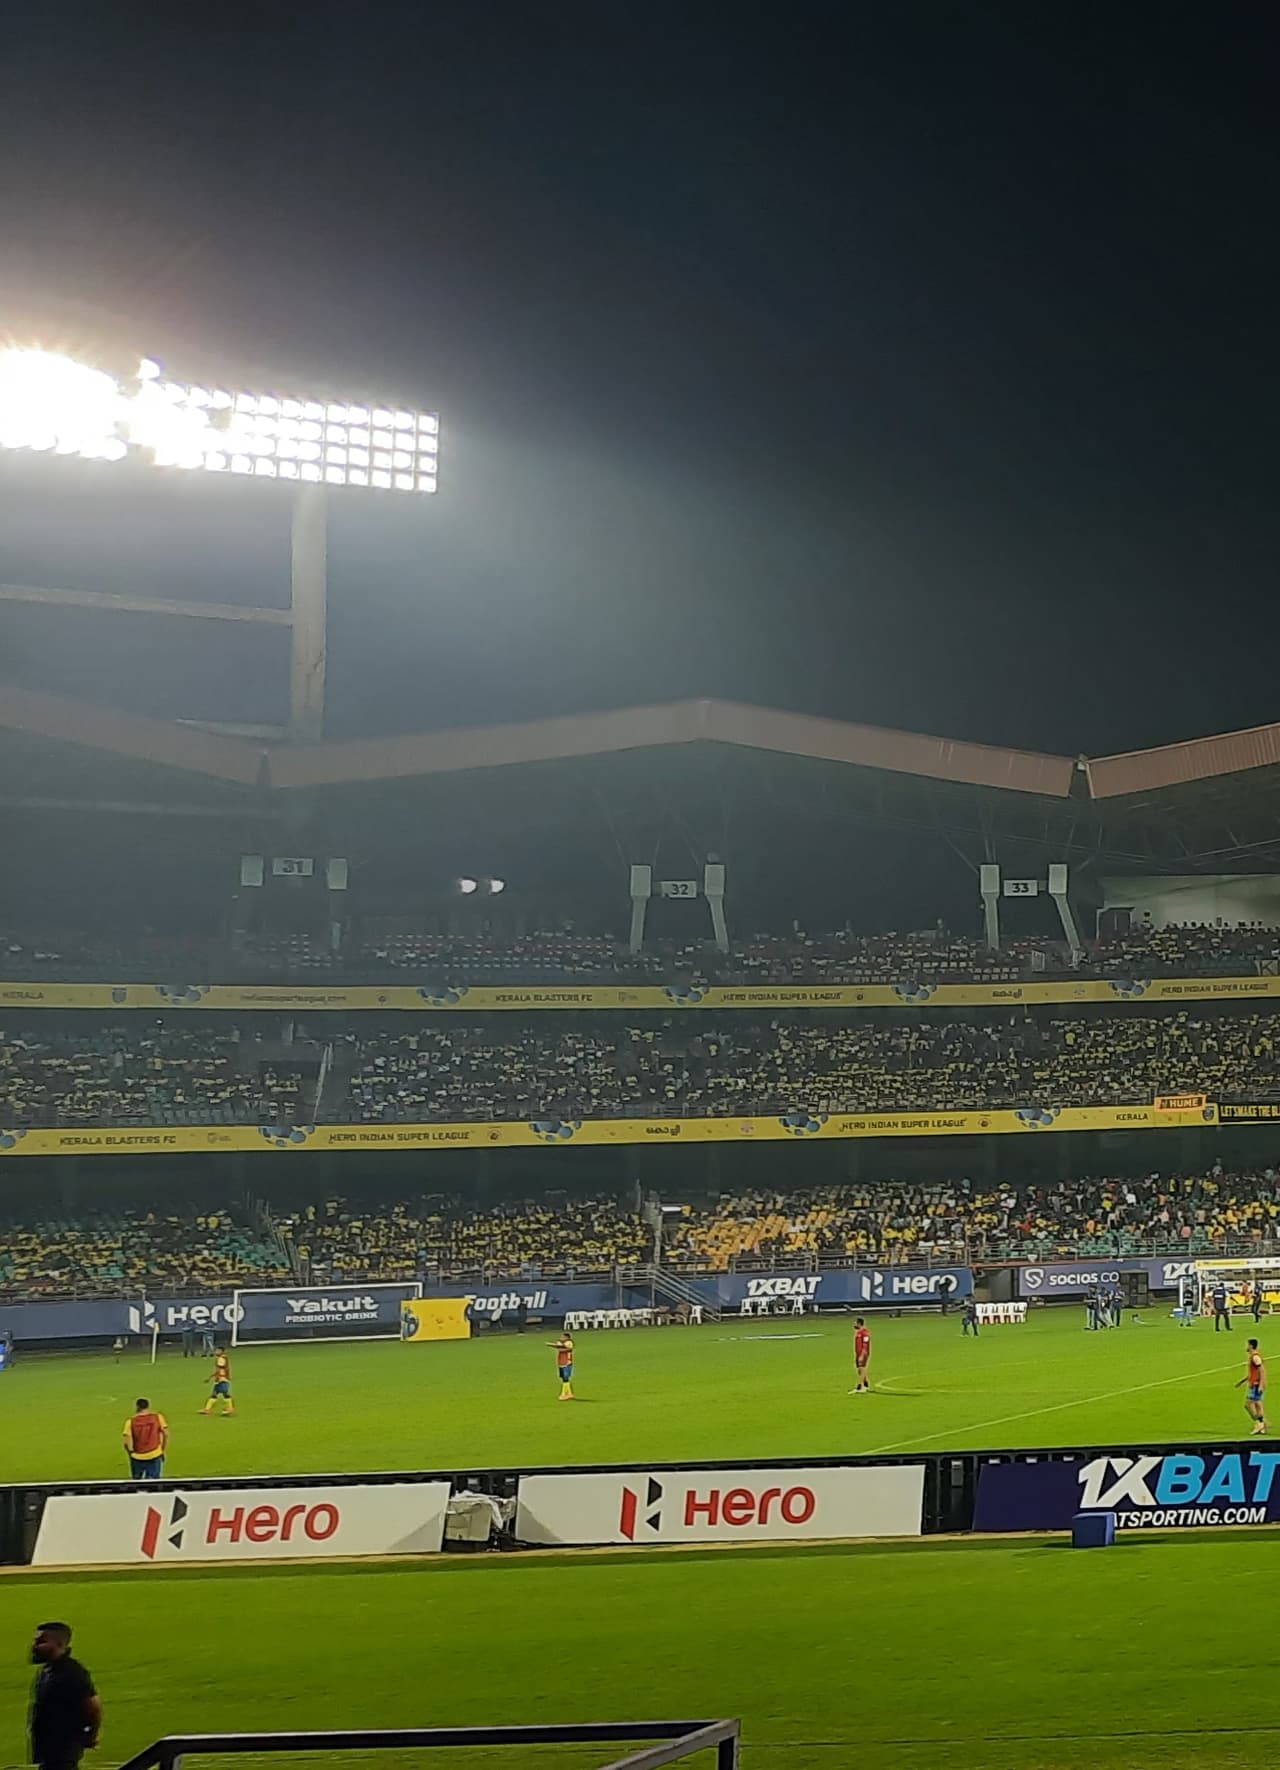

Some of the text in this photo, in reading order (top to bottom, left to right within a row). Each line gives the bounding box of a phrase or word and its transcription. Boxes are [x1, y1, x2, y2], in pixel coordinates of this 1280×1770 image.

[672, 884, 690, 895] 32
[1012, 883, 1030, 894] 33
[2, 991, 44, 1000] KERALA
[1161, 983, 1269, 996] HERO INDIAN SUPER LEAGUE
[495, 993, 593, 1002] KERALA BLASTERS FC
[723, 992, 841, 1002] HERO INDIAN SUPER LEAGUE
[1115, 1113, 1148, 1121] KERALA
[841, 1118, 966, 1131] HERO INDIAN SUPER LEAGUE
[59, 1135, 176, 1146] KERALA BLASTERS FC
[329, 1131, 470, 1144] HERO INDIAN SUPER LEAGUE
[747, 1276, 823, 1296] 1XBAT
[892, 1273, 957, 1294] Hero
[286, 1296, 379, 1314] Yakult
[167, 1302, 245, 1326] Hero
[285, 1311, 379, 1323] PROBIOTIC DRINK
[684, 1485, 815, 1527] Hero
[206, 1502, 340, 1544] Hero
